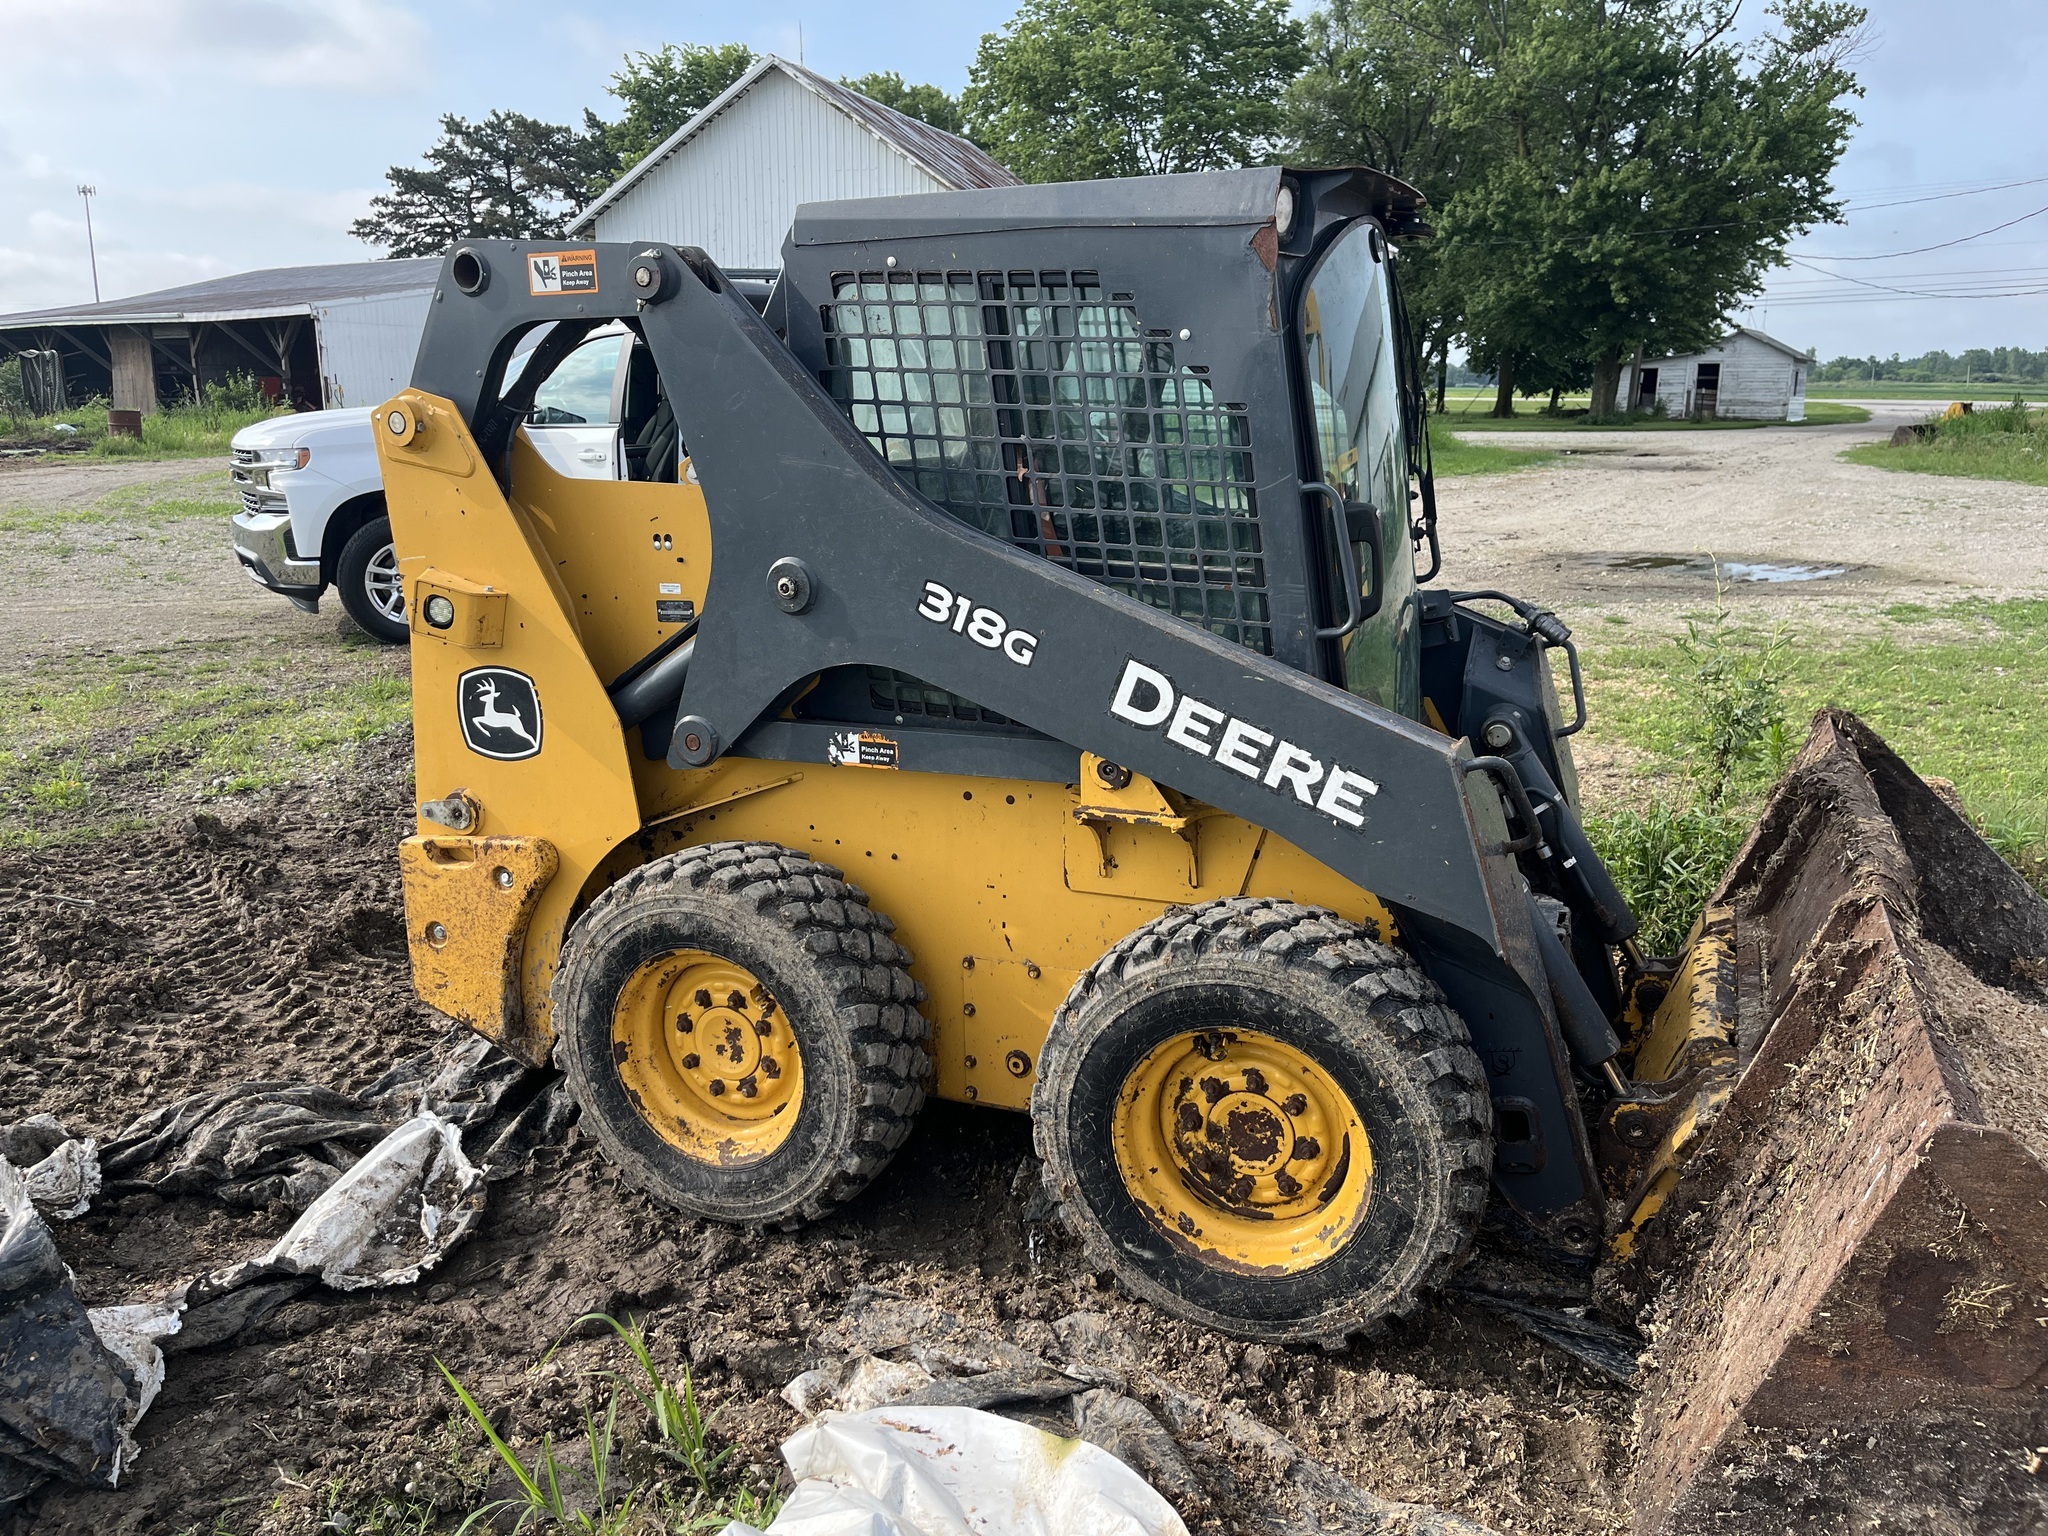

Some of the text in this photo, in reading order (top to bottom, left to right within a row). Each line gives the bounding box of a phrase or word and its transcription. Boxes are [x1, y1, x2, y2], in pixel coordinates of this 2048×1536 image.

[918, 581, 1037, 666] 318G
[861, 746, 878, 754] Pinch
[1110, 659, 1380, 827] DEERE
